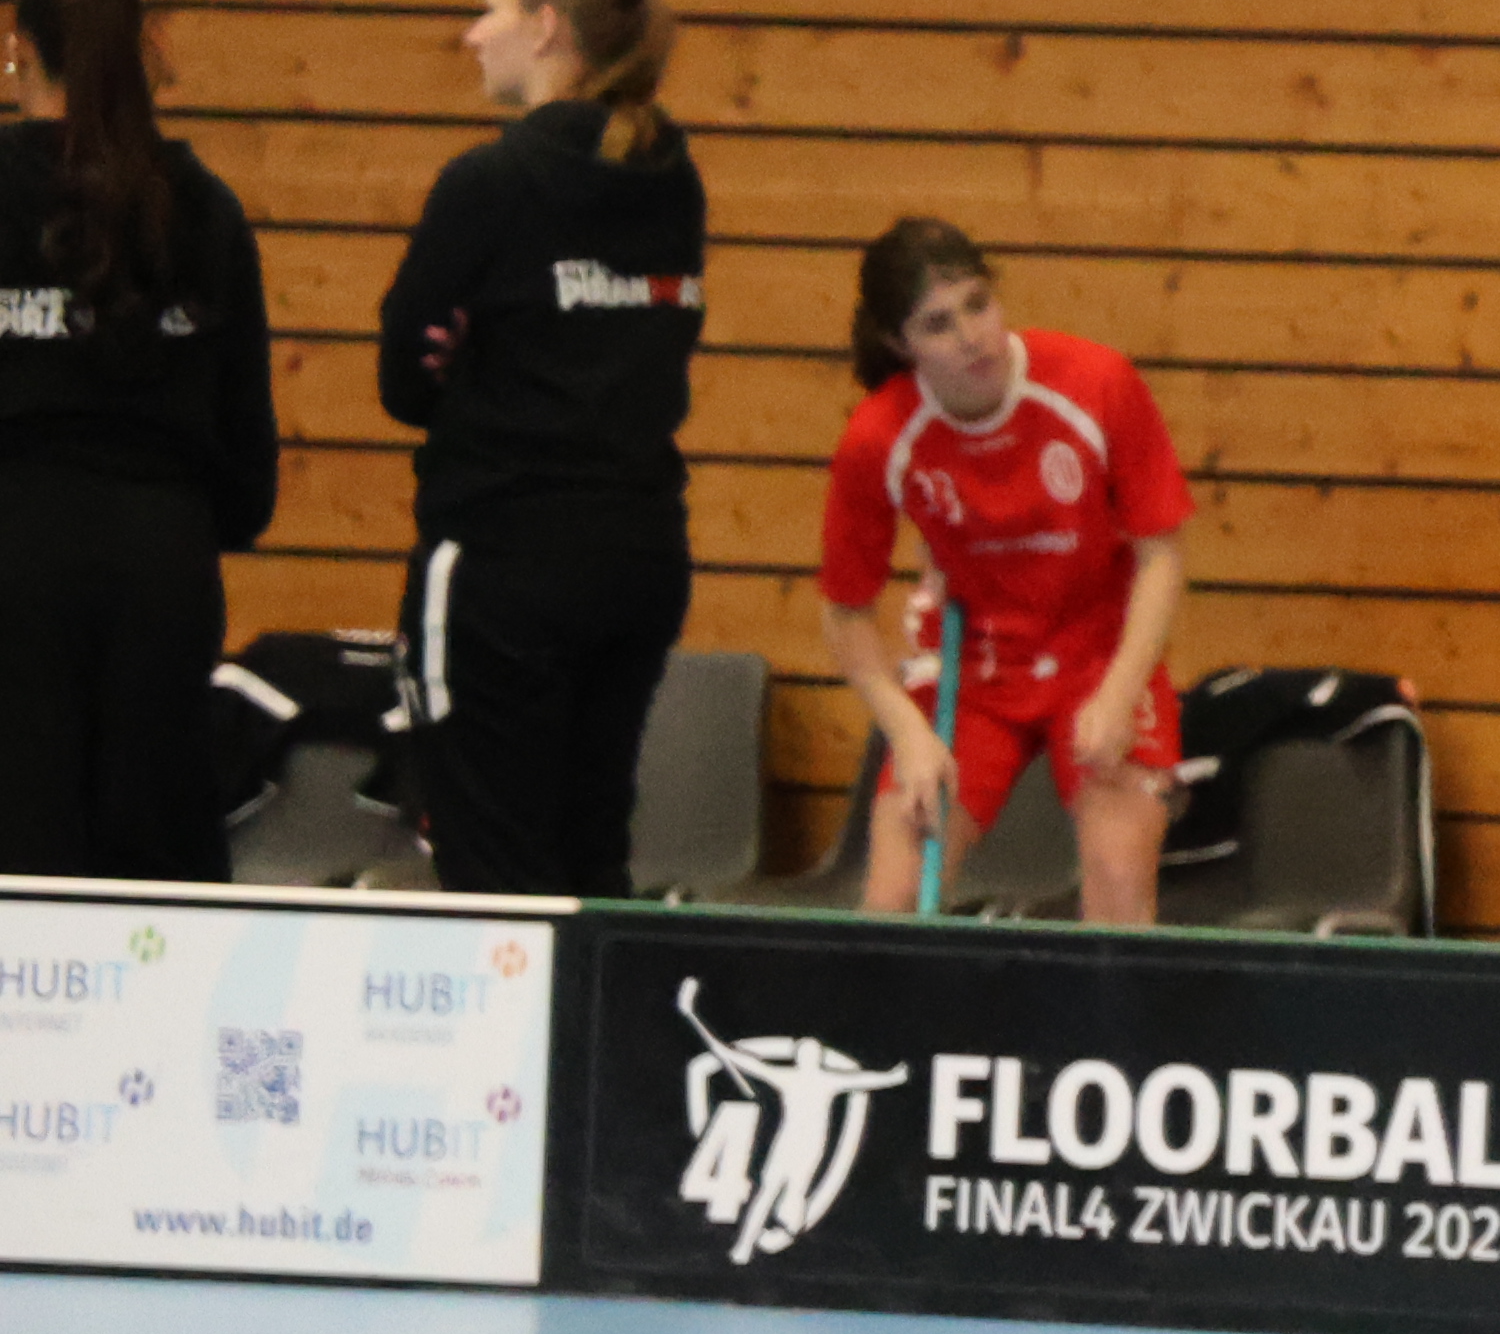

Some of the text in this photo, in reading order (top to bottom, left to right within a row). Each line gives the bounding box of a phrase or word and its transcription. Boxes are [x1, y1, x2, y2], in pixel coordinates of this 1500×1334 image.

[133, 1203, 374, 1244] www.hubit.de
[924, 1174, 1117, 1240] FINAL4
[1129, 1186, 1388, 1255] ZWICKAU
